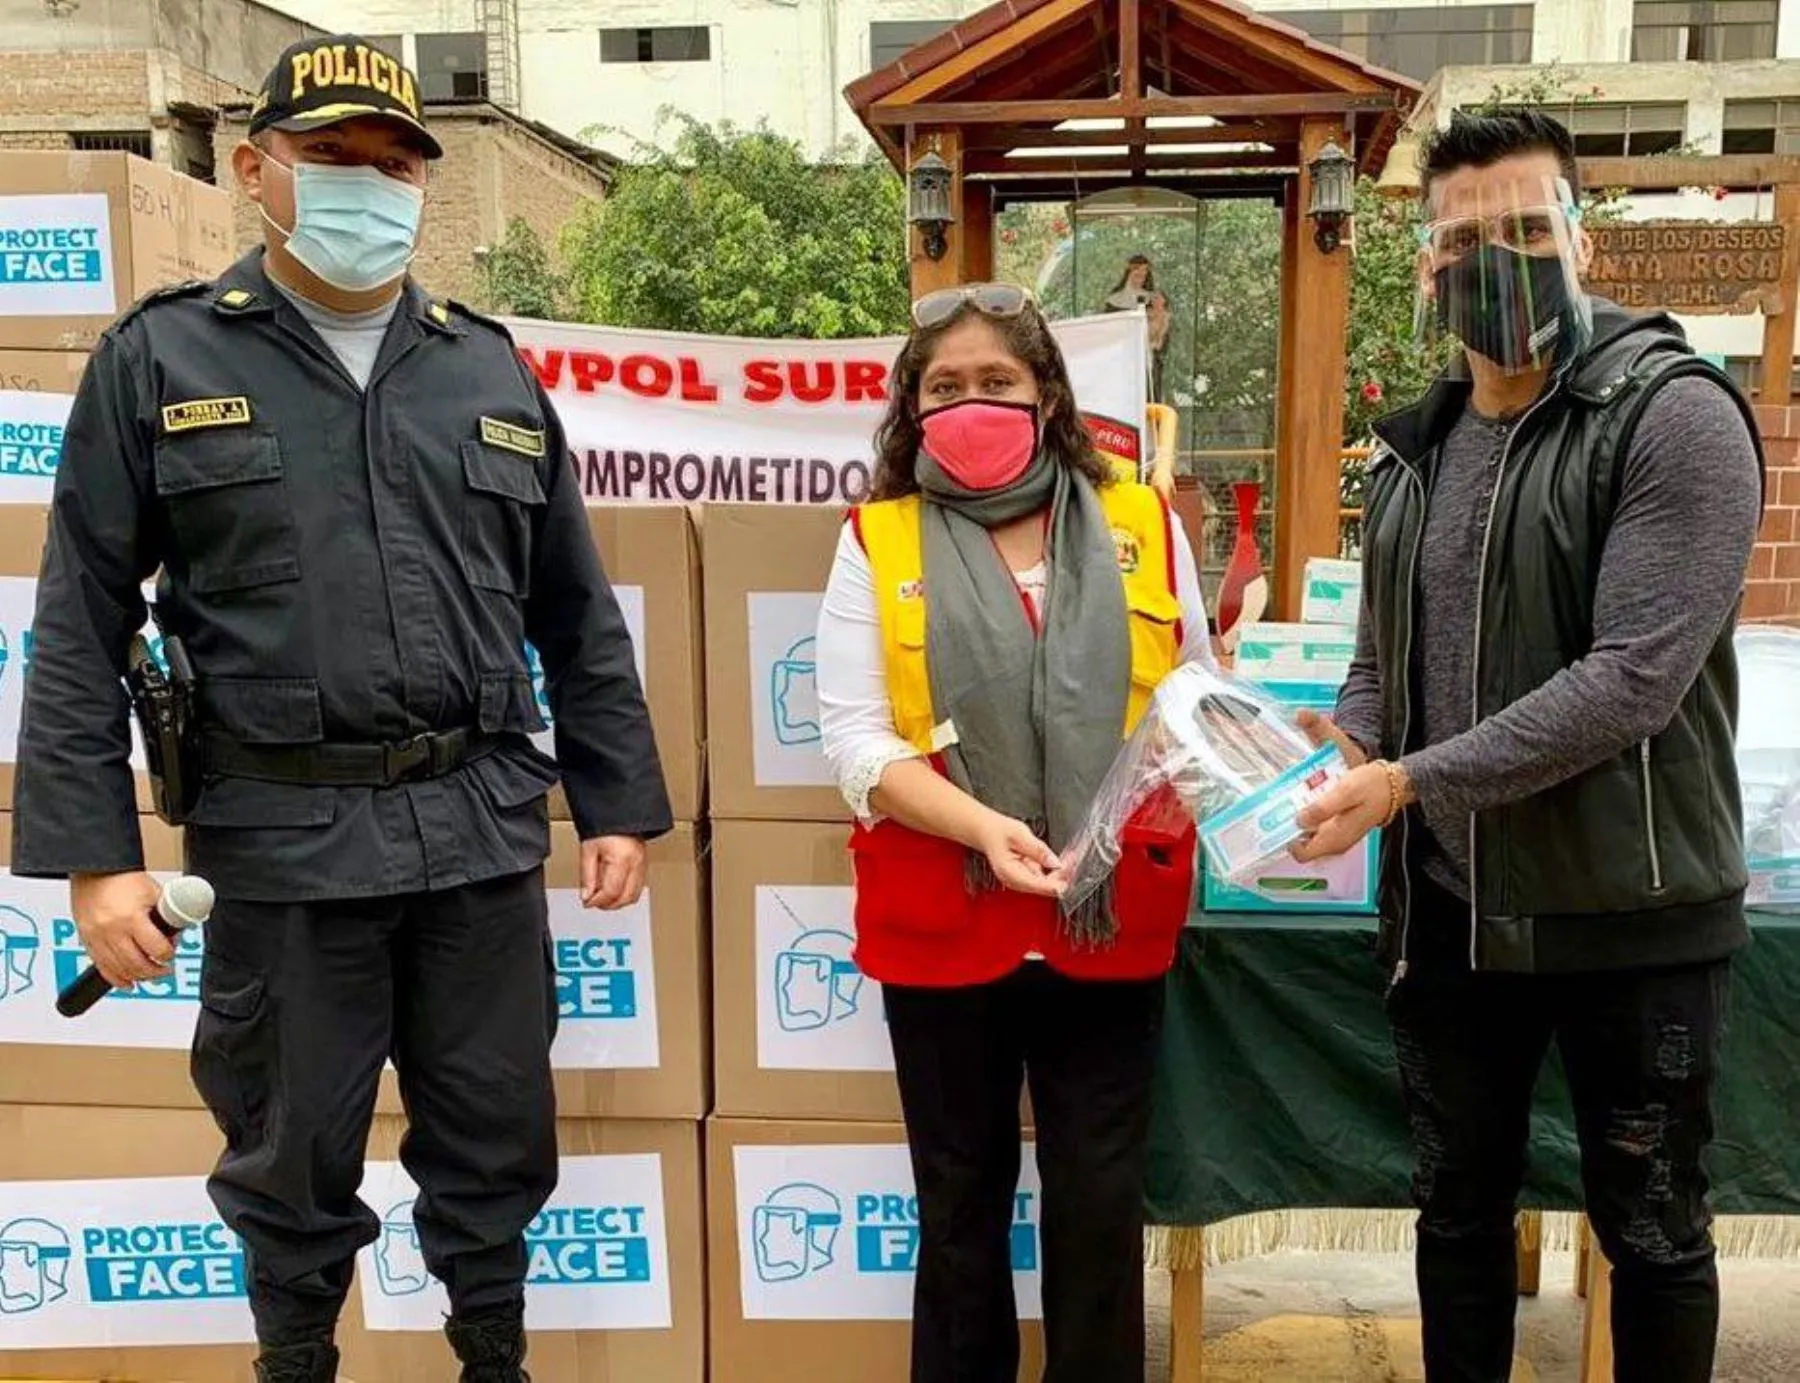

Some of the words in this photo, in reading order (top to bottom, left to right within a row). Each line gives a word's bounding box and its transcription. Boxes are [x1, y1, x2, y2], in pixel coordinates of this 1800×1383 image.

[291, 44, 420, 118] POLICIA
[1621, 230, 1646, 249] DE
[1652, 229, 1691, 250] LOS
[1700, 228, 1783, 249] DESEOS
[5, 253, 88, 280] FACE
[1692, 252, 1776, 280] ROSA
[1614, 283, 1644, 304] DE
[743, 360, 889, 402] SUR
[0, 423, 62, 444] ROTE
[0, 446, 59, 475] FAC
[556, 937, 632, 969] ECT
[83, 1222, 244, 1254] PROTEC
[526, 1241, 627, 1280] ACE
[107, 1258, 236, 1297] FACE
